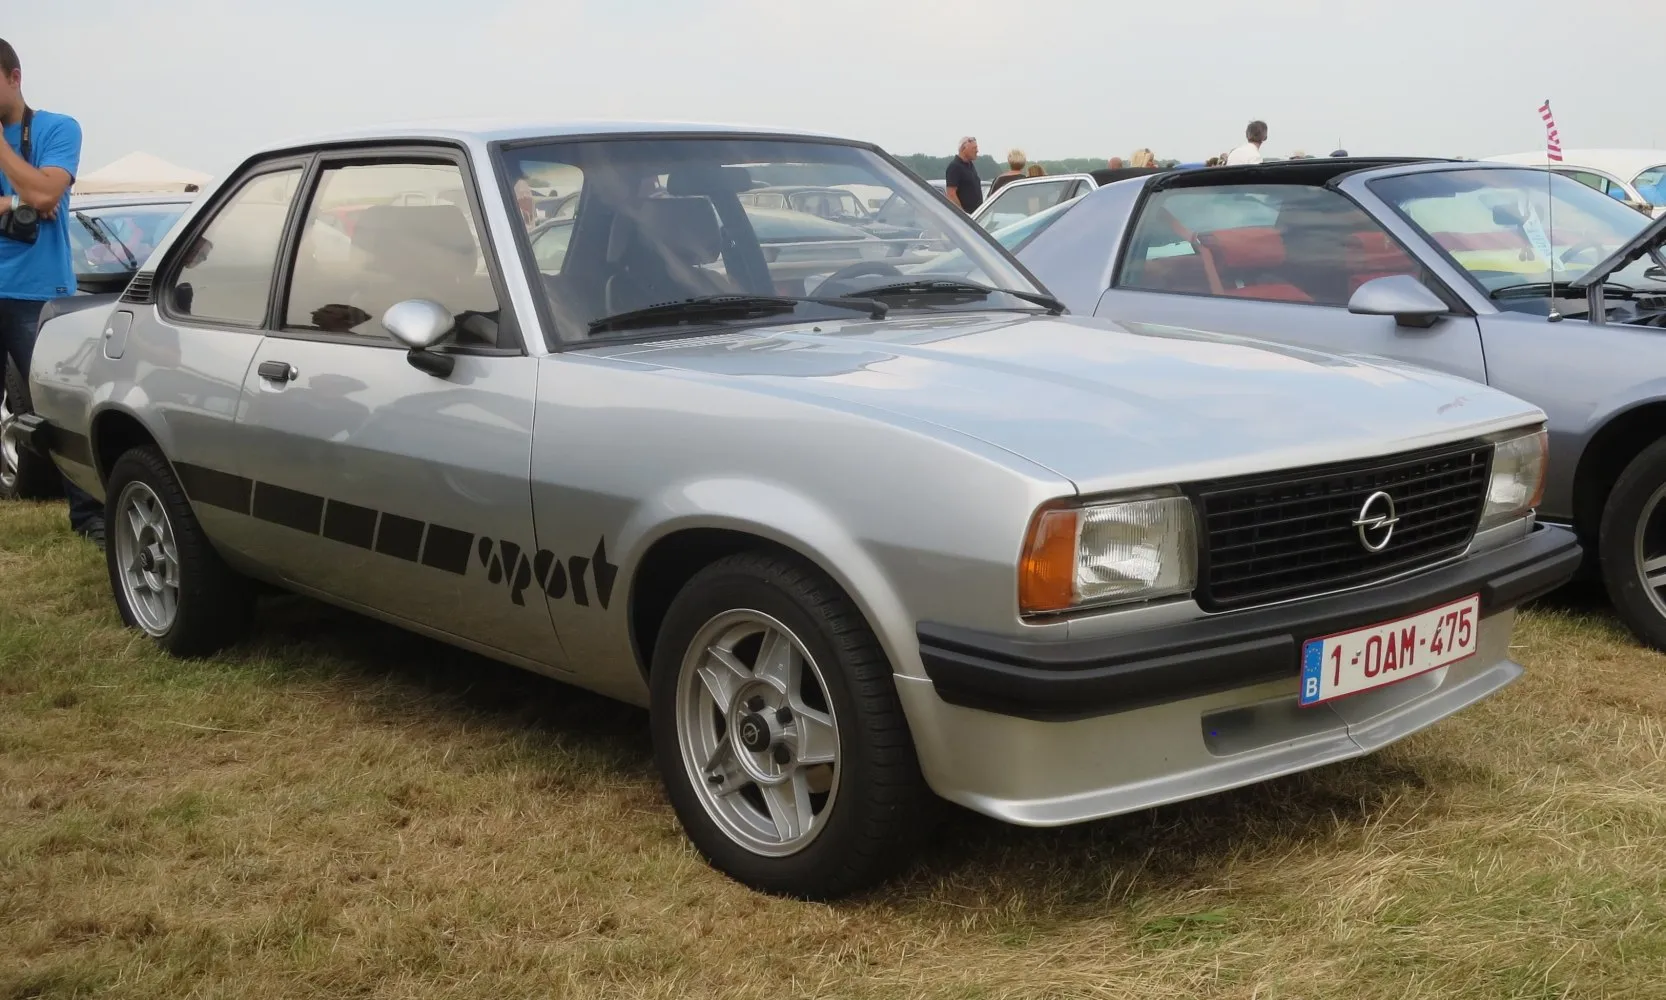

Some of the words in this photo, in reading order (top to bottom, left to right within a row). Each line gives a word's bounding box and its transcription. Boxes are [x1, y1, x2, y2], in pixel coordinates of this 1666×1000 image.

[478, 534, 619, 610] sport
[1331, 606, 1472, 687] 1-OAM-475
[1305, 677, 1318, 697] B
